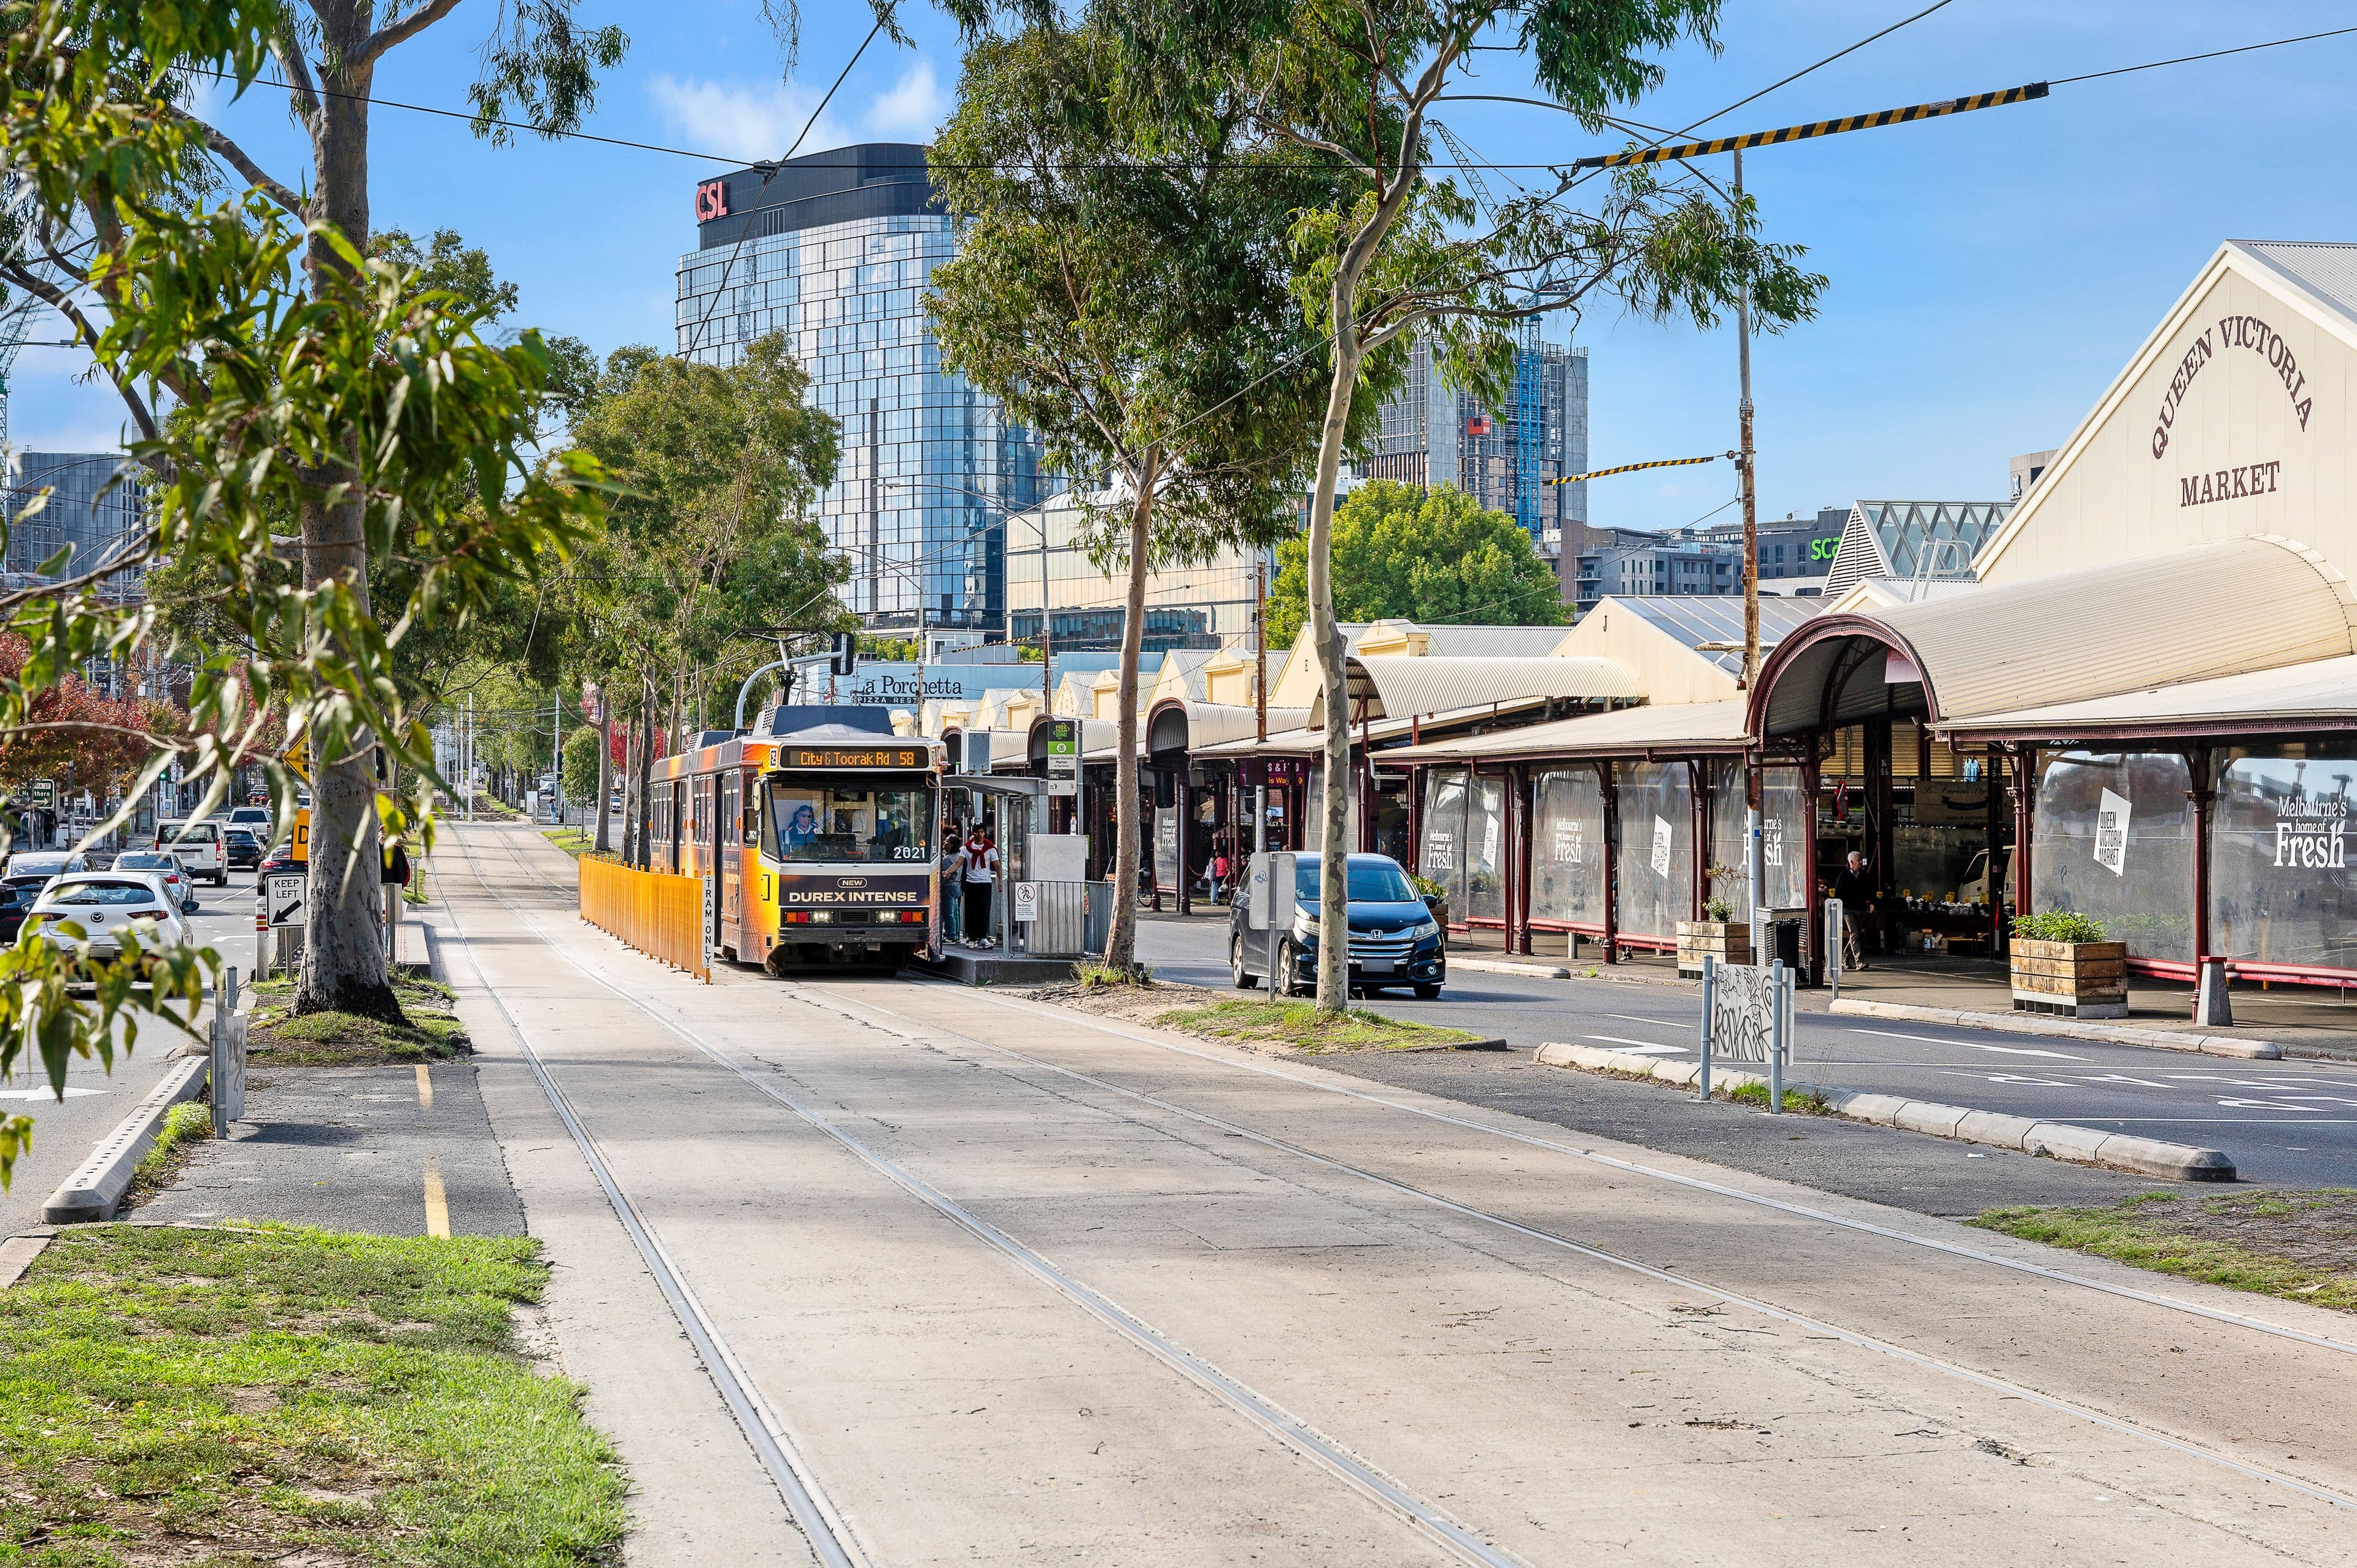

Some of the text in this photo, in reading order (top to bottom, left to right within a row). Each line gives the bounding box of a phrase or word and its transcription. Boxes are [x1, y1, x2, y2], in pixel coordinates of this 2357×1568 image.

[695, 180, 727, 222] CSL
[2153, 315, 2312, 460] QUEEN VICTORIA
[2180, 460, 2280, 507] MARKET
[1603, 615, 1608, 632] J
[800, 752, 914, 765] City & Toorak Rd 58
[2277, 795, 2347, 817] Melbourne's
[1556, 817, 1582, 832] Melbourne's
[2100, 811, 2116, 828] QUEEN
[2296, 818, 2327, 833] home of
[2099, 829, 2122, 848] VICTORIA
[2274, 820, 2346, 868] Fresh
[894, 847, 926, 859] 2021
[1427, 843, 1453, 870] Fresh
[1555, 833, 1582, 863] Fresh
[2099, 848, 2119, 866] MARKET
[274, 879, 300, 888] KEEP
[276, 890, 298, 898] LEFT
[789, 892, 917, 902] DUREX INTENSE
